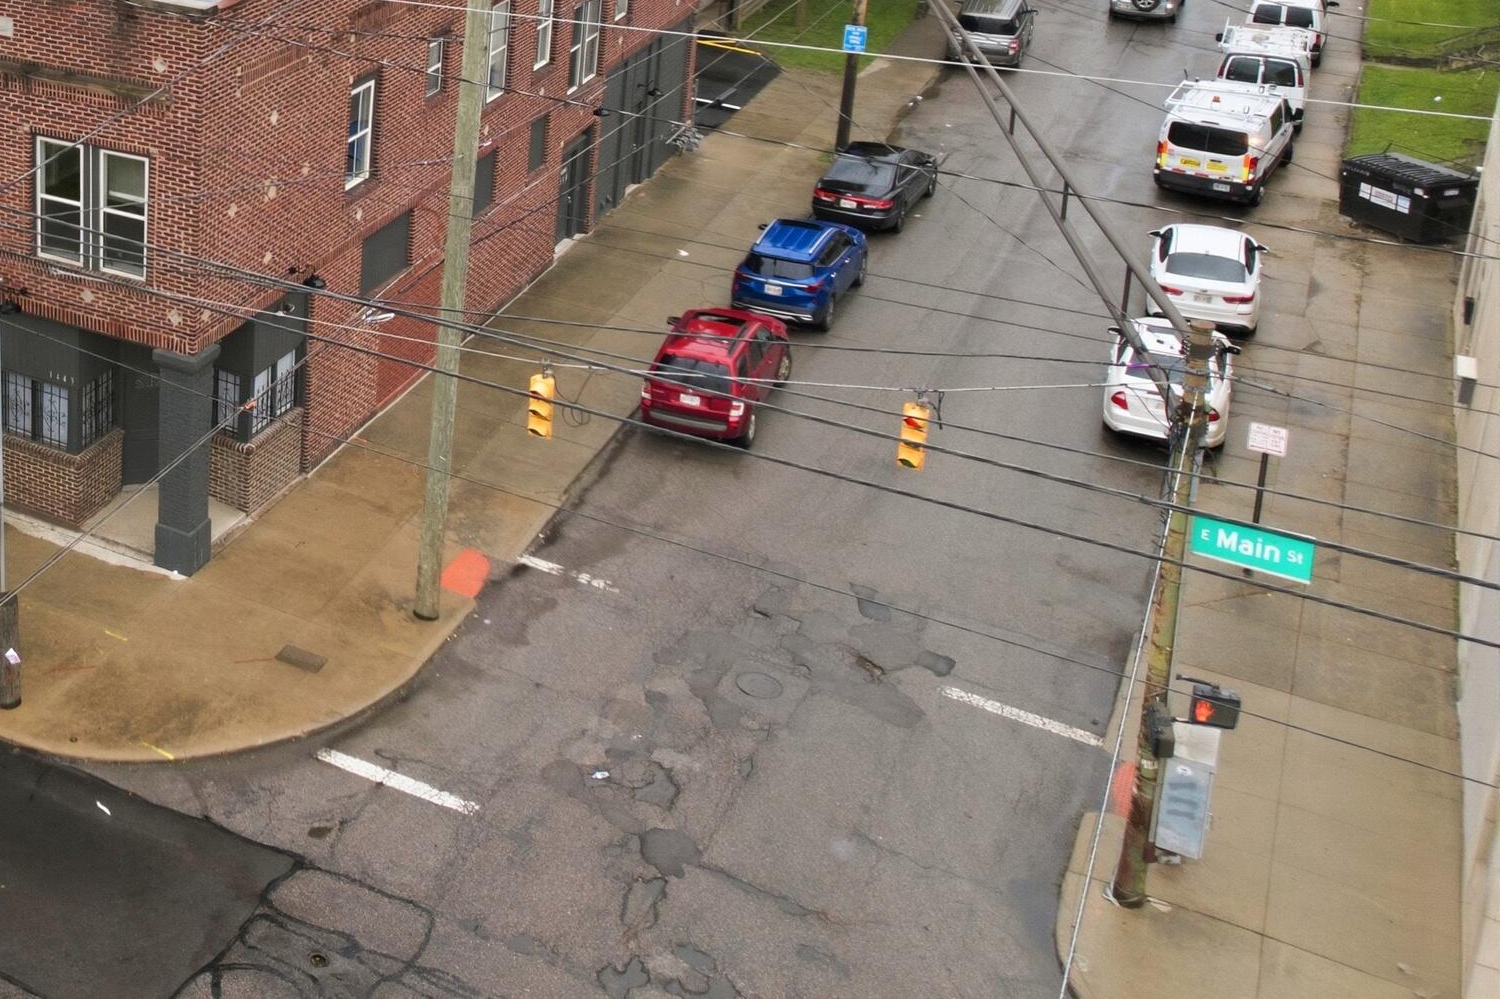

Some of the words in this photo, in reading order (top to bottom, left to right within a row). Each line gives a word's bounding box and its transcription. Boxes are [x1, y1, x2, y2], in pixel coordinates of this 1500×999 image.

[1201, 528, 1211, 541] E
[1216, 528, 1280, 564] Main
[1286, 549, 1305, 565] St
